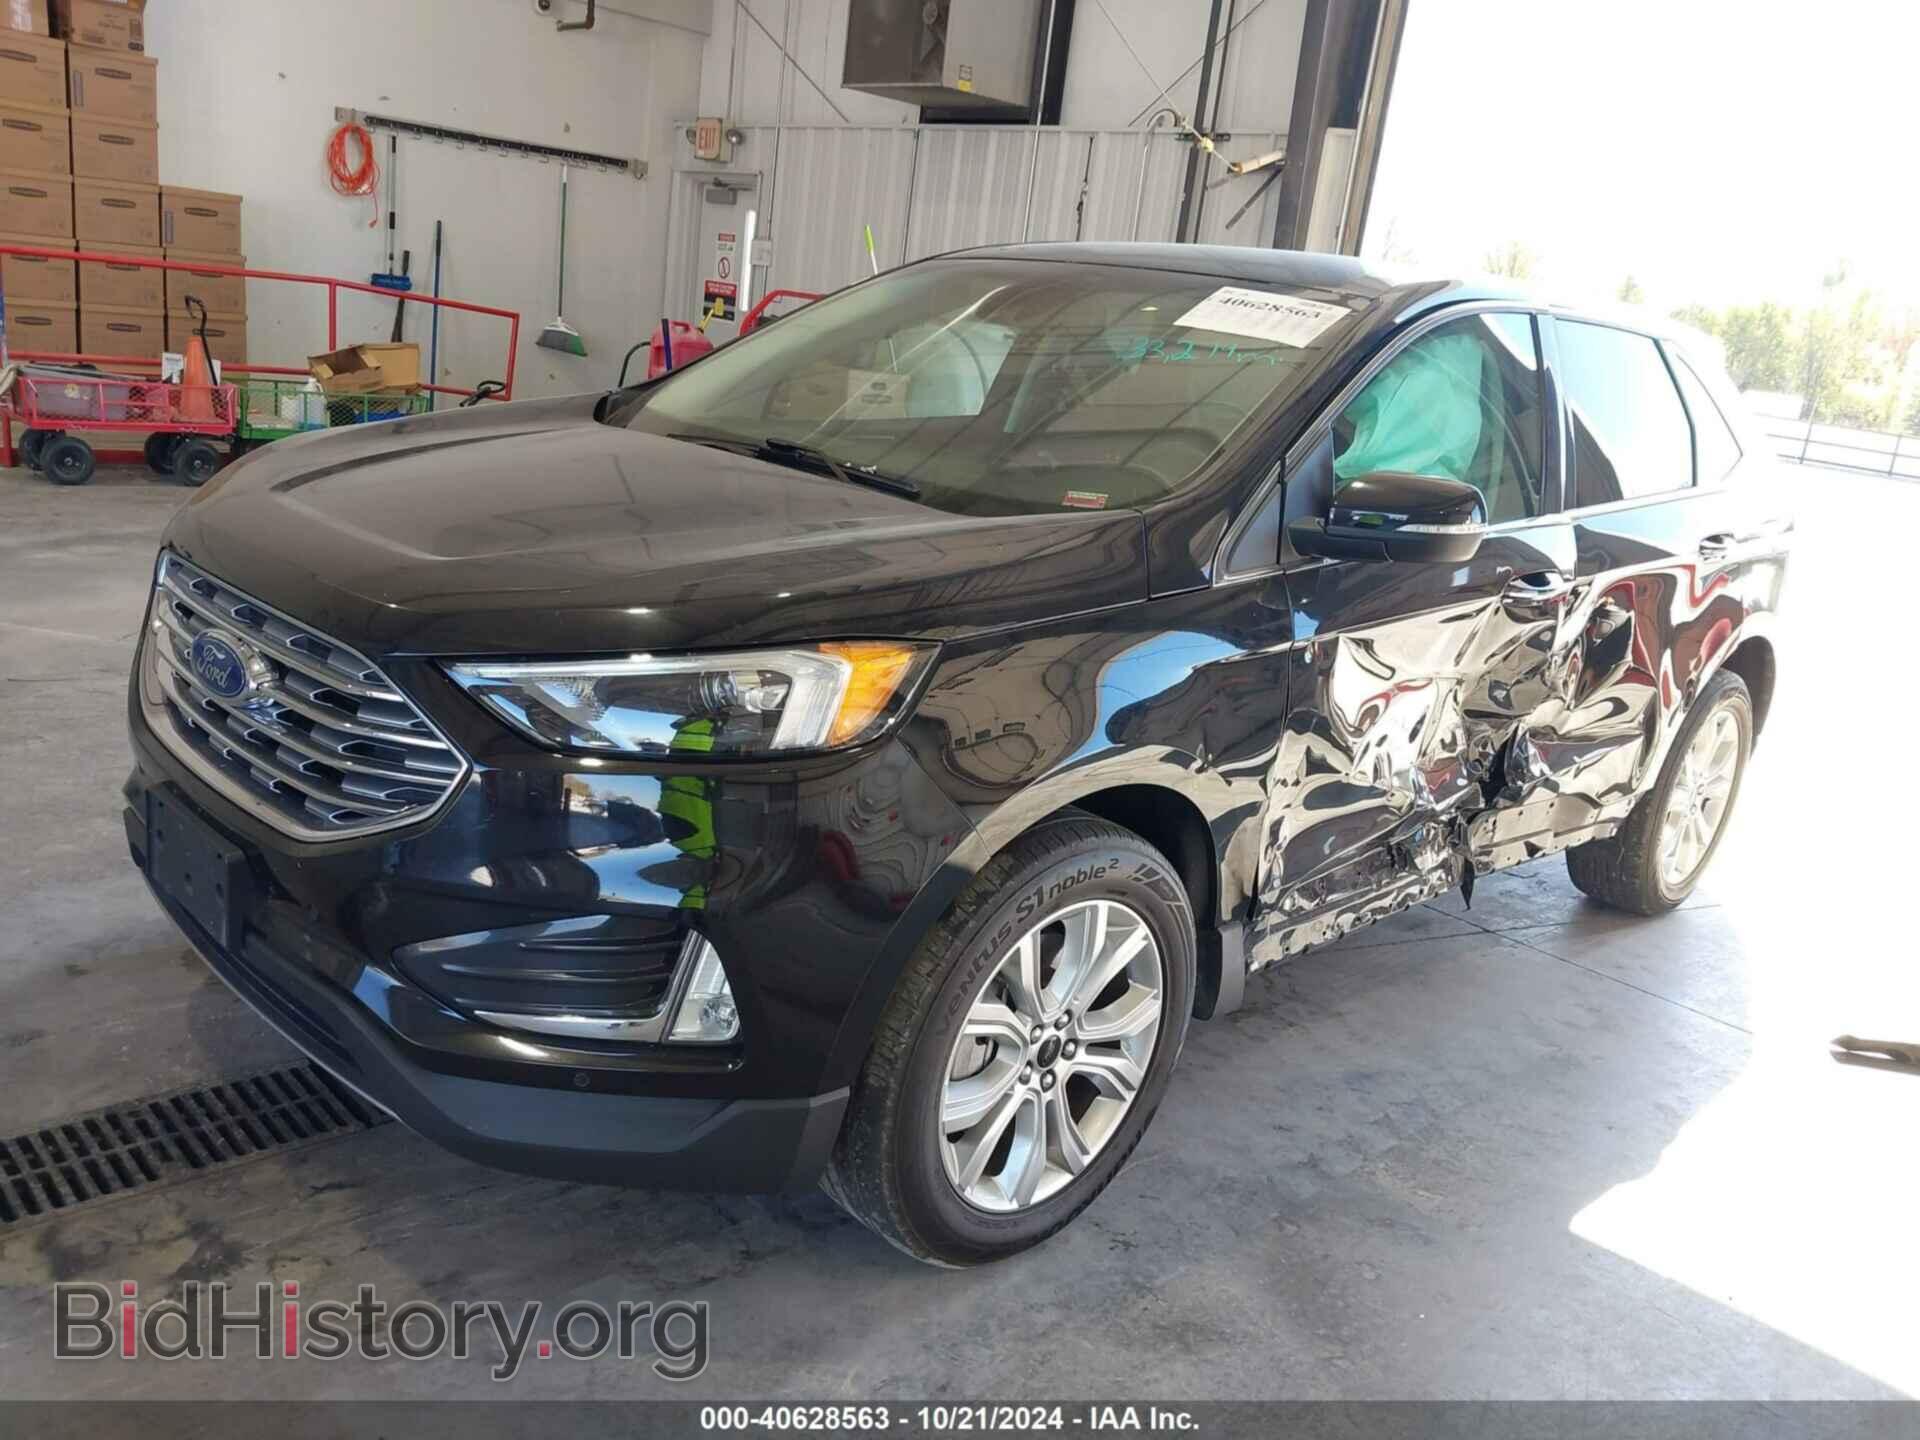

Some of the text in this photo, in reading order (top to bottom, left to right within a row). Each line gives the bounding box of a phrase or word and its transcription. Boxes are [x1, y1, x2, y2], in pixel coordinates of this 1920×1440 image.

[698, 126, 717, 150] EXIT
[196, 644, 233, 689] Ford
[1015, 885, 1046, 924] S1
